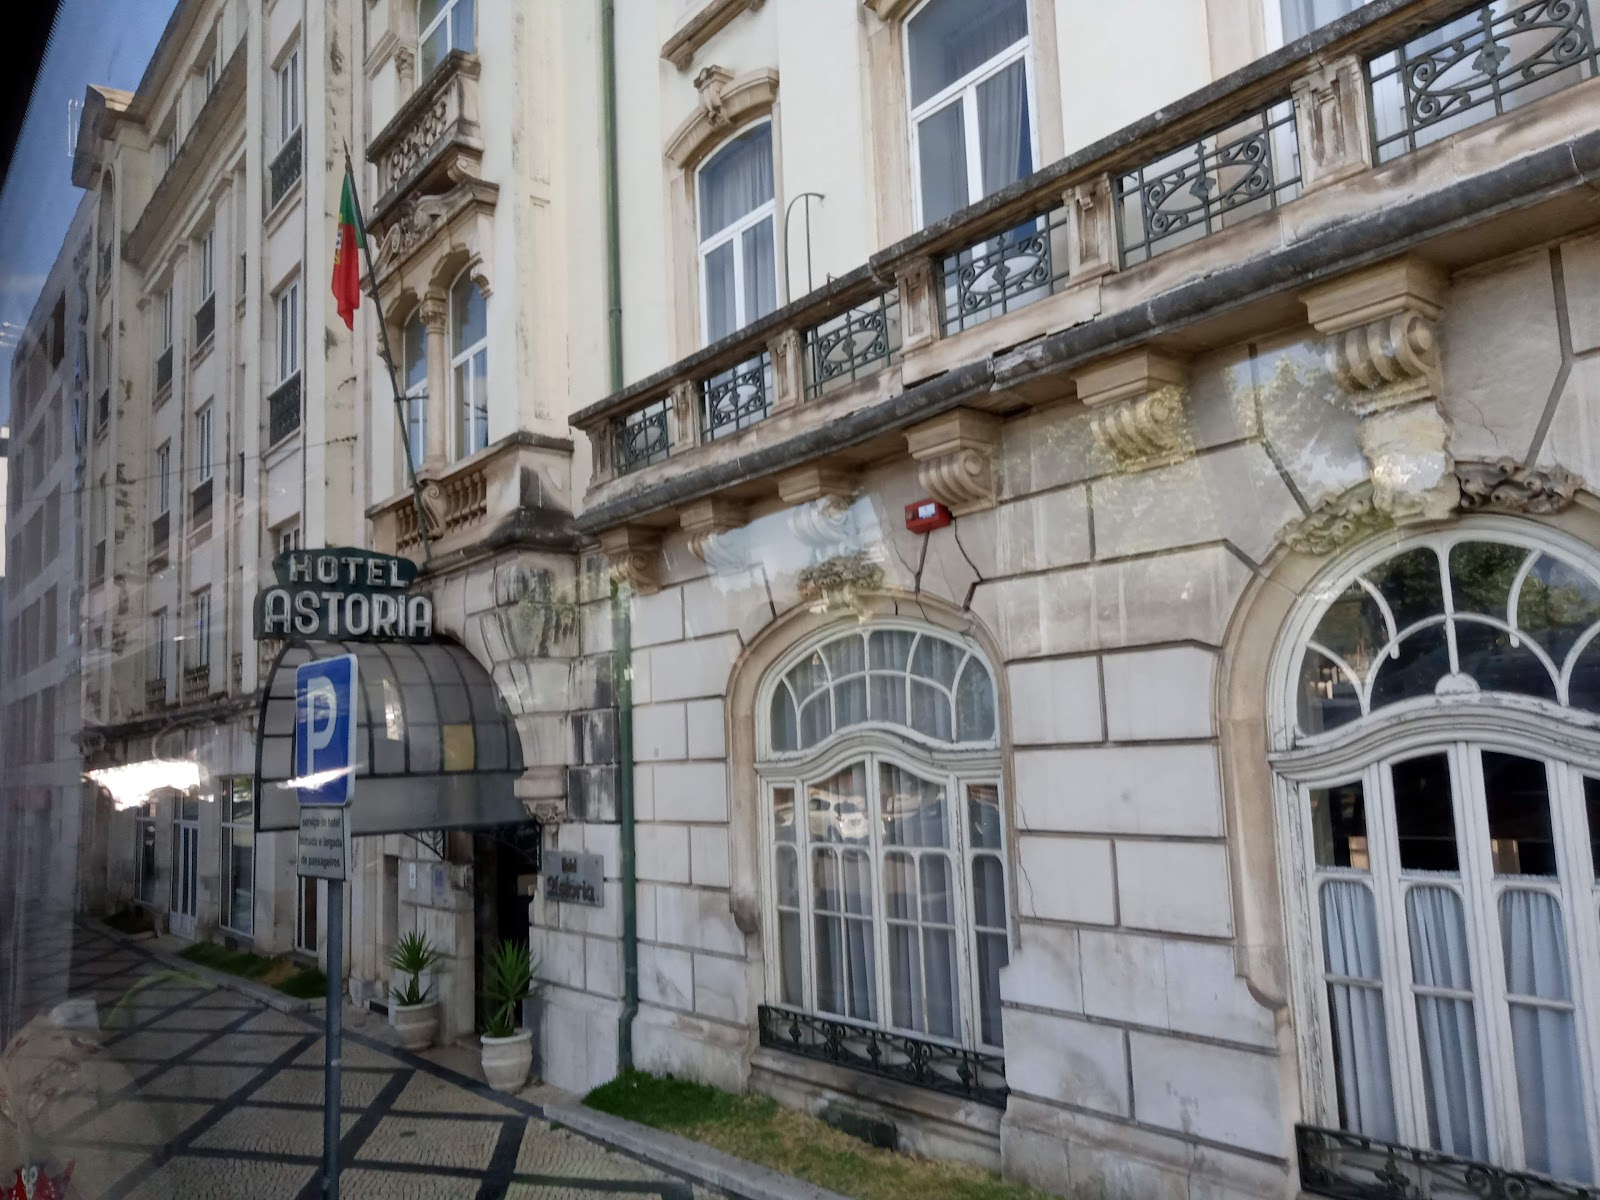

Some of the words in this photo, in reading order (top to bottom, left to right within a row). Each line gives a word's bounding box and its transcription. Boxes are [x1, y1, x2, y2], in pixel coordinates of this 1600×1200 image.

[289, 553, 409, 588] HOTEL
[264, 588, 433, 637] ASTORIA
[307, 675, 337, 781] P
